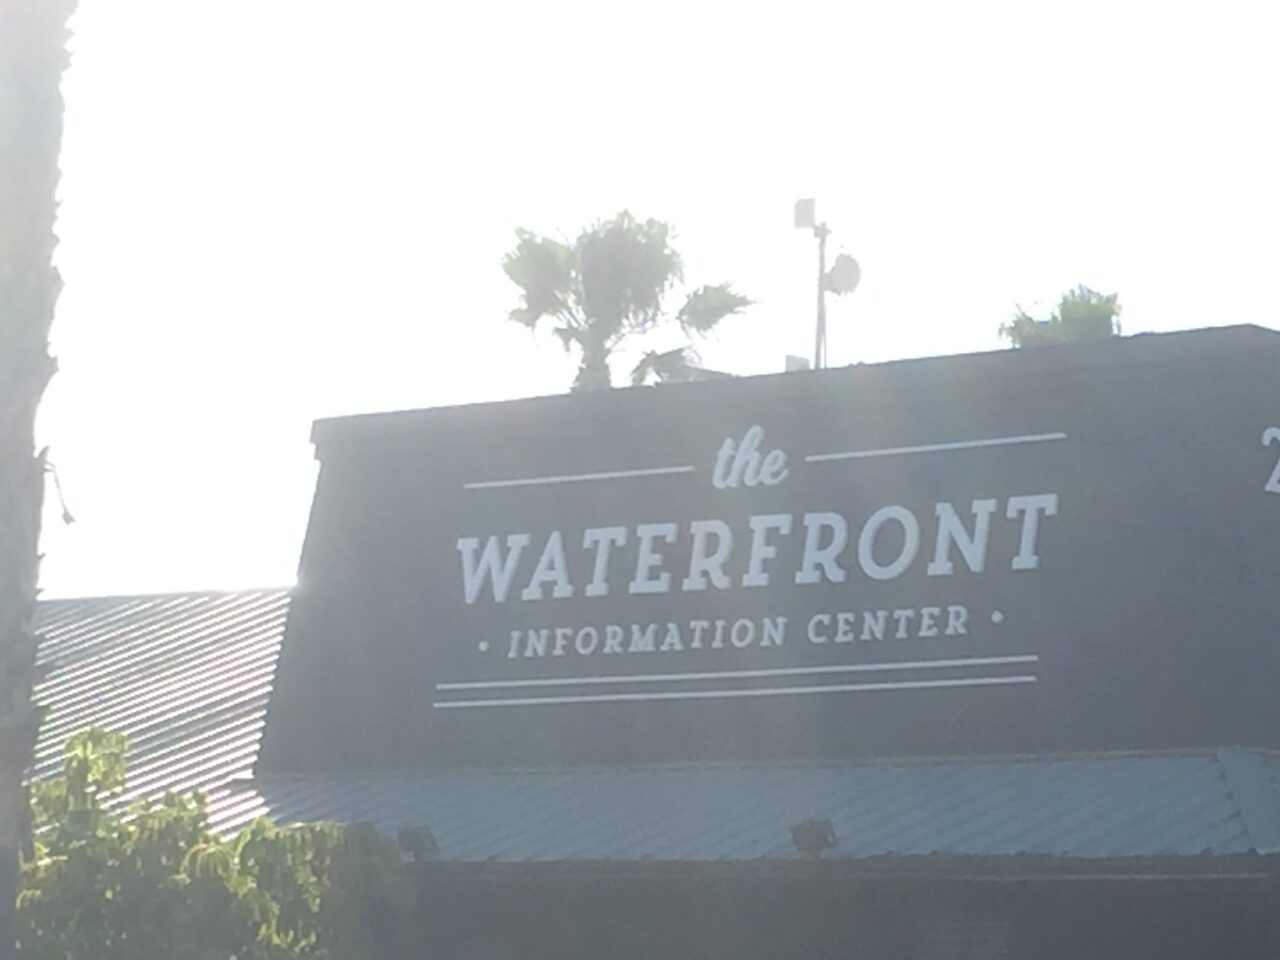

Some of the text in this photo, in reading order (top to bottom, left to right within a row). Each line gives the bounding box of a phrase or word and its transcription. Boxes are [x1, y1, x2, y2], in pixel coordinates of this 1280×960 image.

[711, 426, 789, 489] the
[457, 493, 1058, 604] WATERFRONT
[507, 604, 970, 659] INFORMATION CENTER
